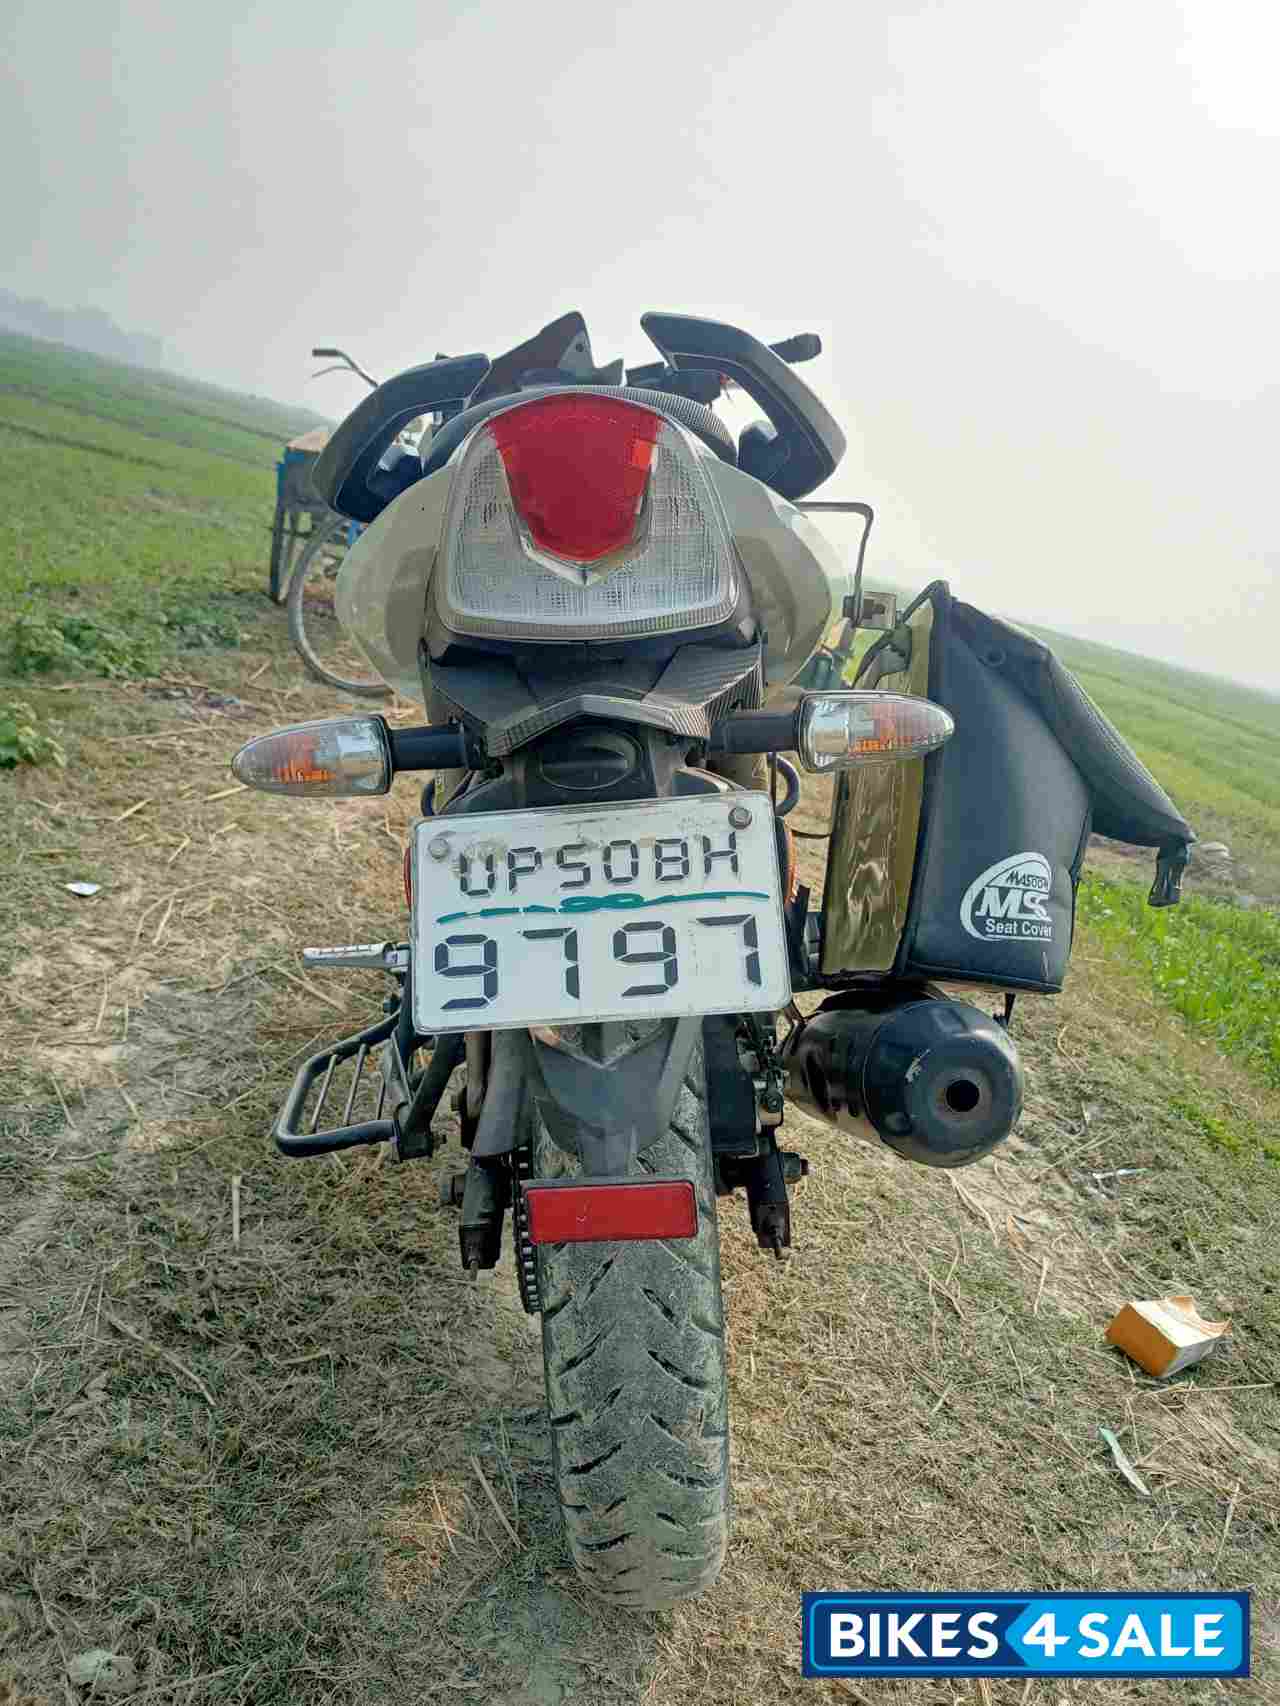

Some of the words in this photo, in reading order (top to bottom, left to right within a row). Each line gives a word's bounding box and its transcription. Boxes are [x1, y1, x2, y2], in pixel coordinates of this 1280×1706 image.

[985, 918, 1018, 934] Seat
[1022, 920, 1053, 937] Cover
[434, 914, 762, 1010] 9797
